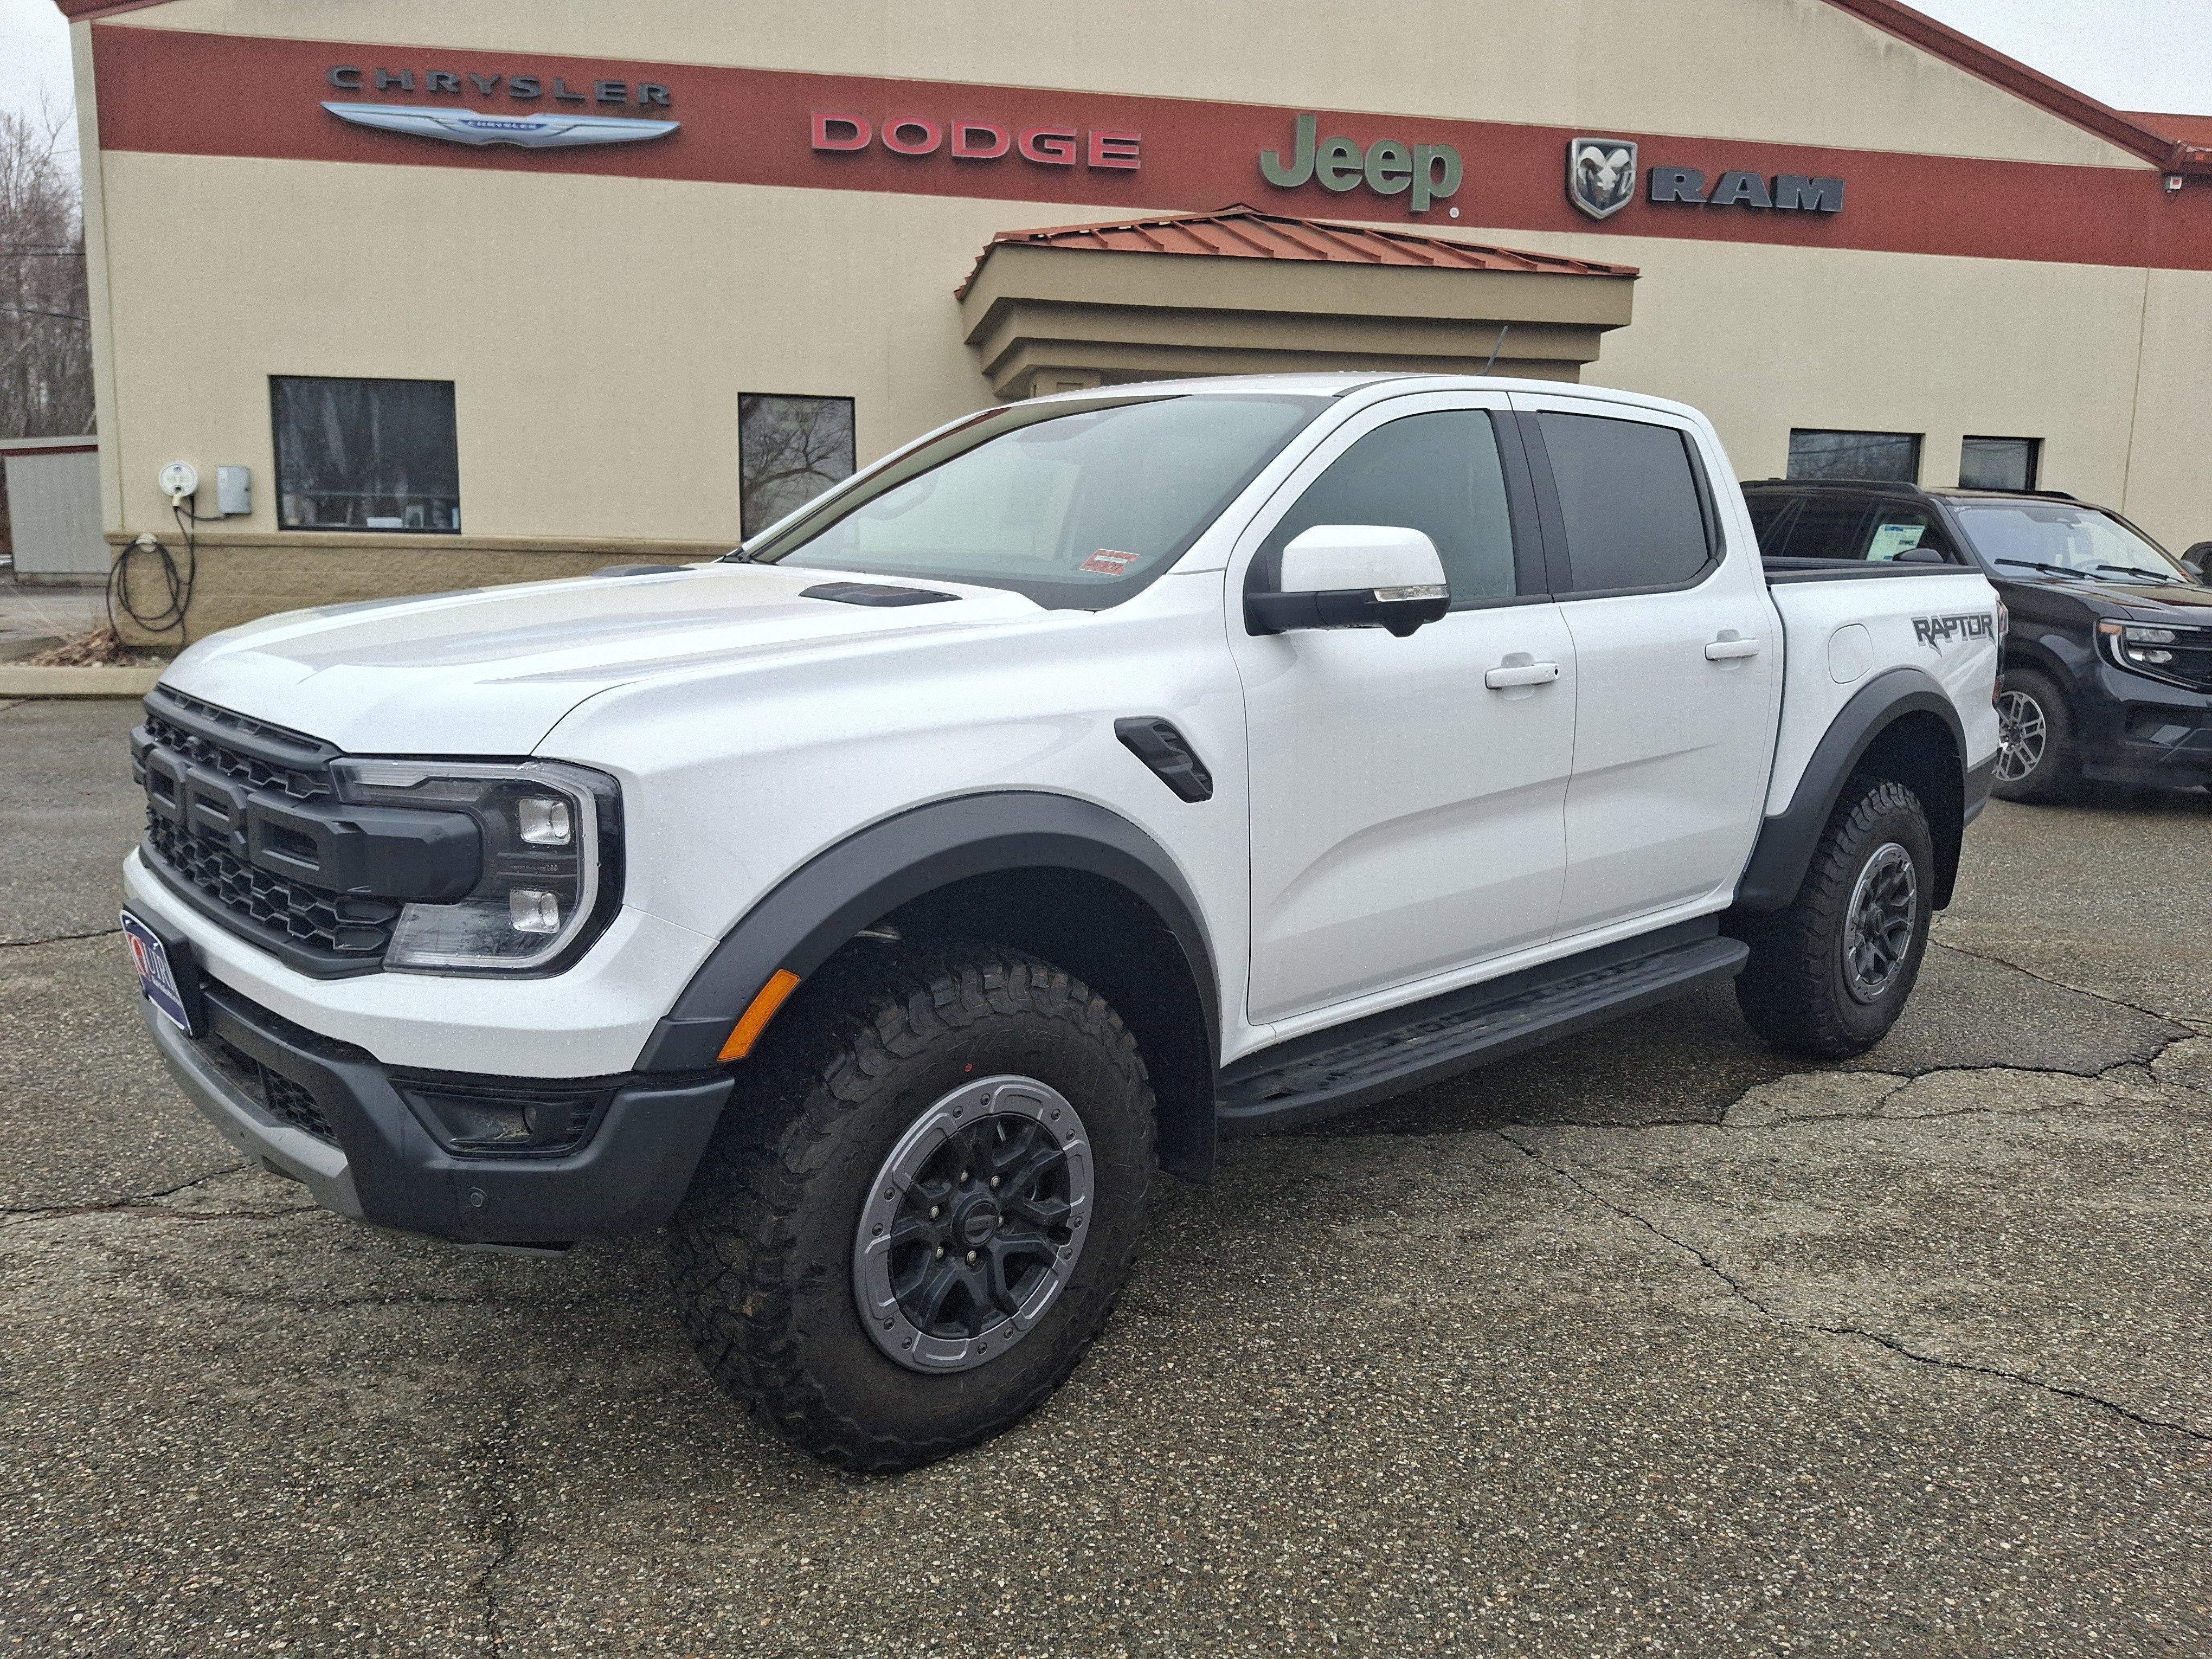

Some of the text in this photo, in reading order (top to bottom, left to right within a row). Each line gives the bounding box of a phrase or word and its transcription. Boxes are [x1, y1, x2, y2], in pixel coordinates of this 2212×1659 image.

[326, 65, 671, 105] CHRYSLER
[811, 111, 1141, 169] DODGE
[1260, 113, 1463, 213] Jeep
[1650, 166, 1845, 213] RAM
[1911, 612, 1997, 658] RAPTOR
